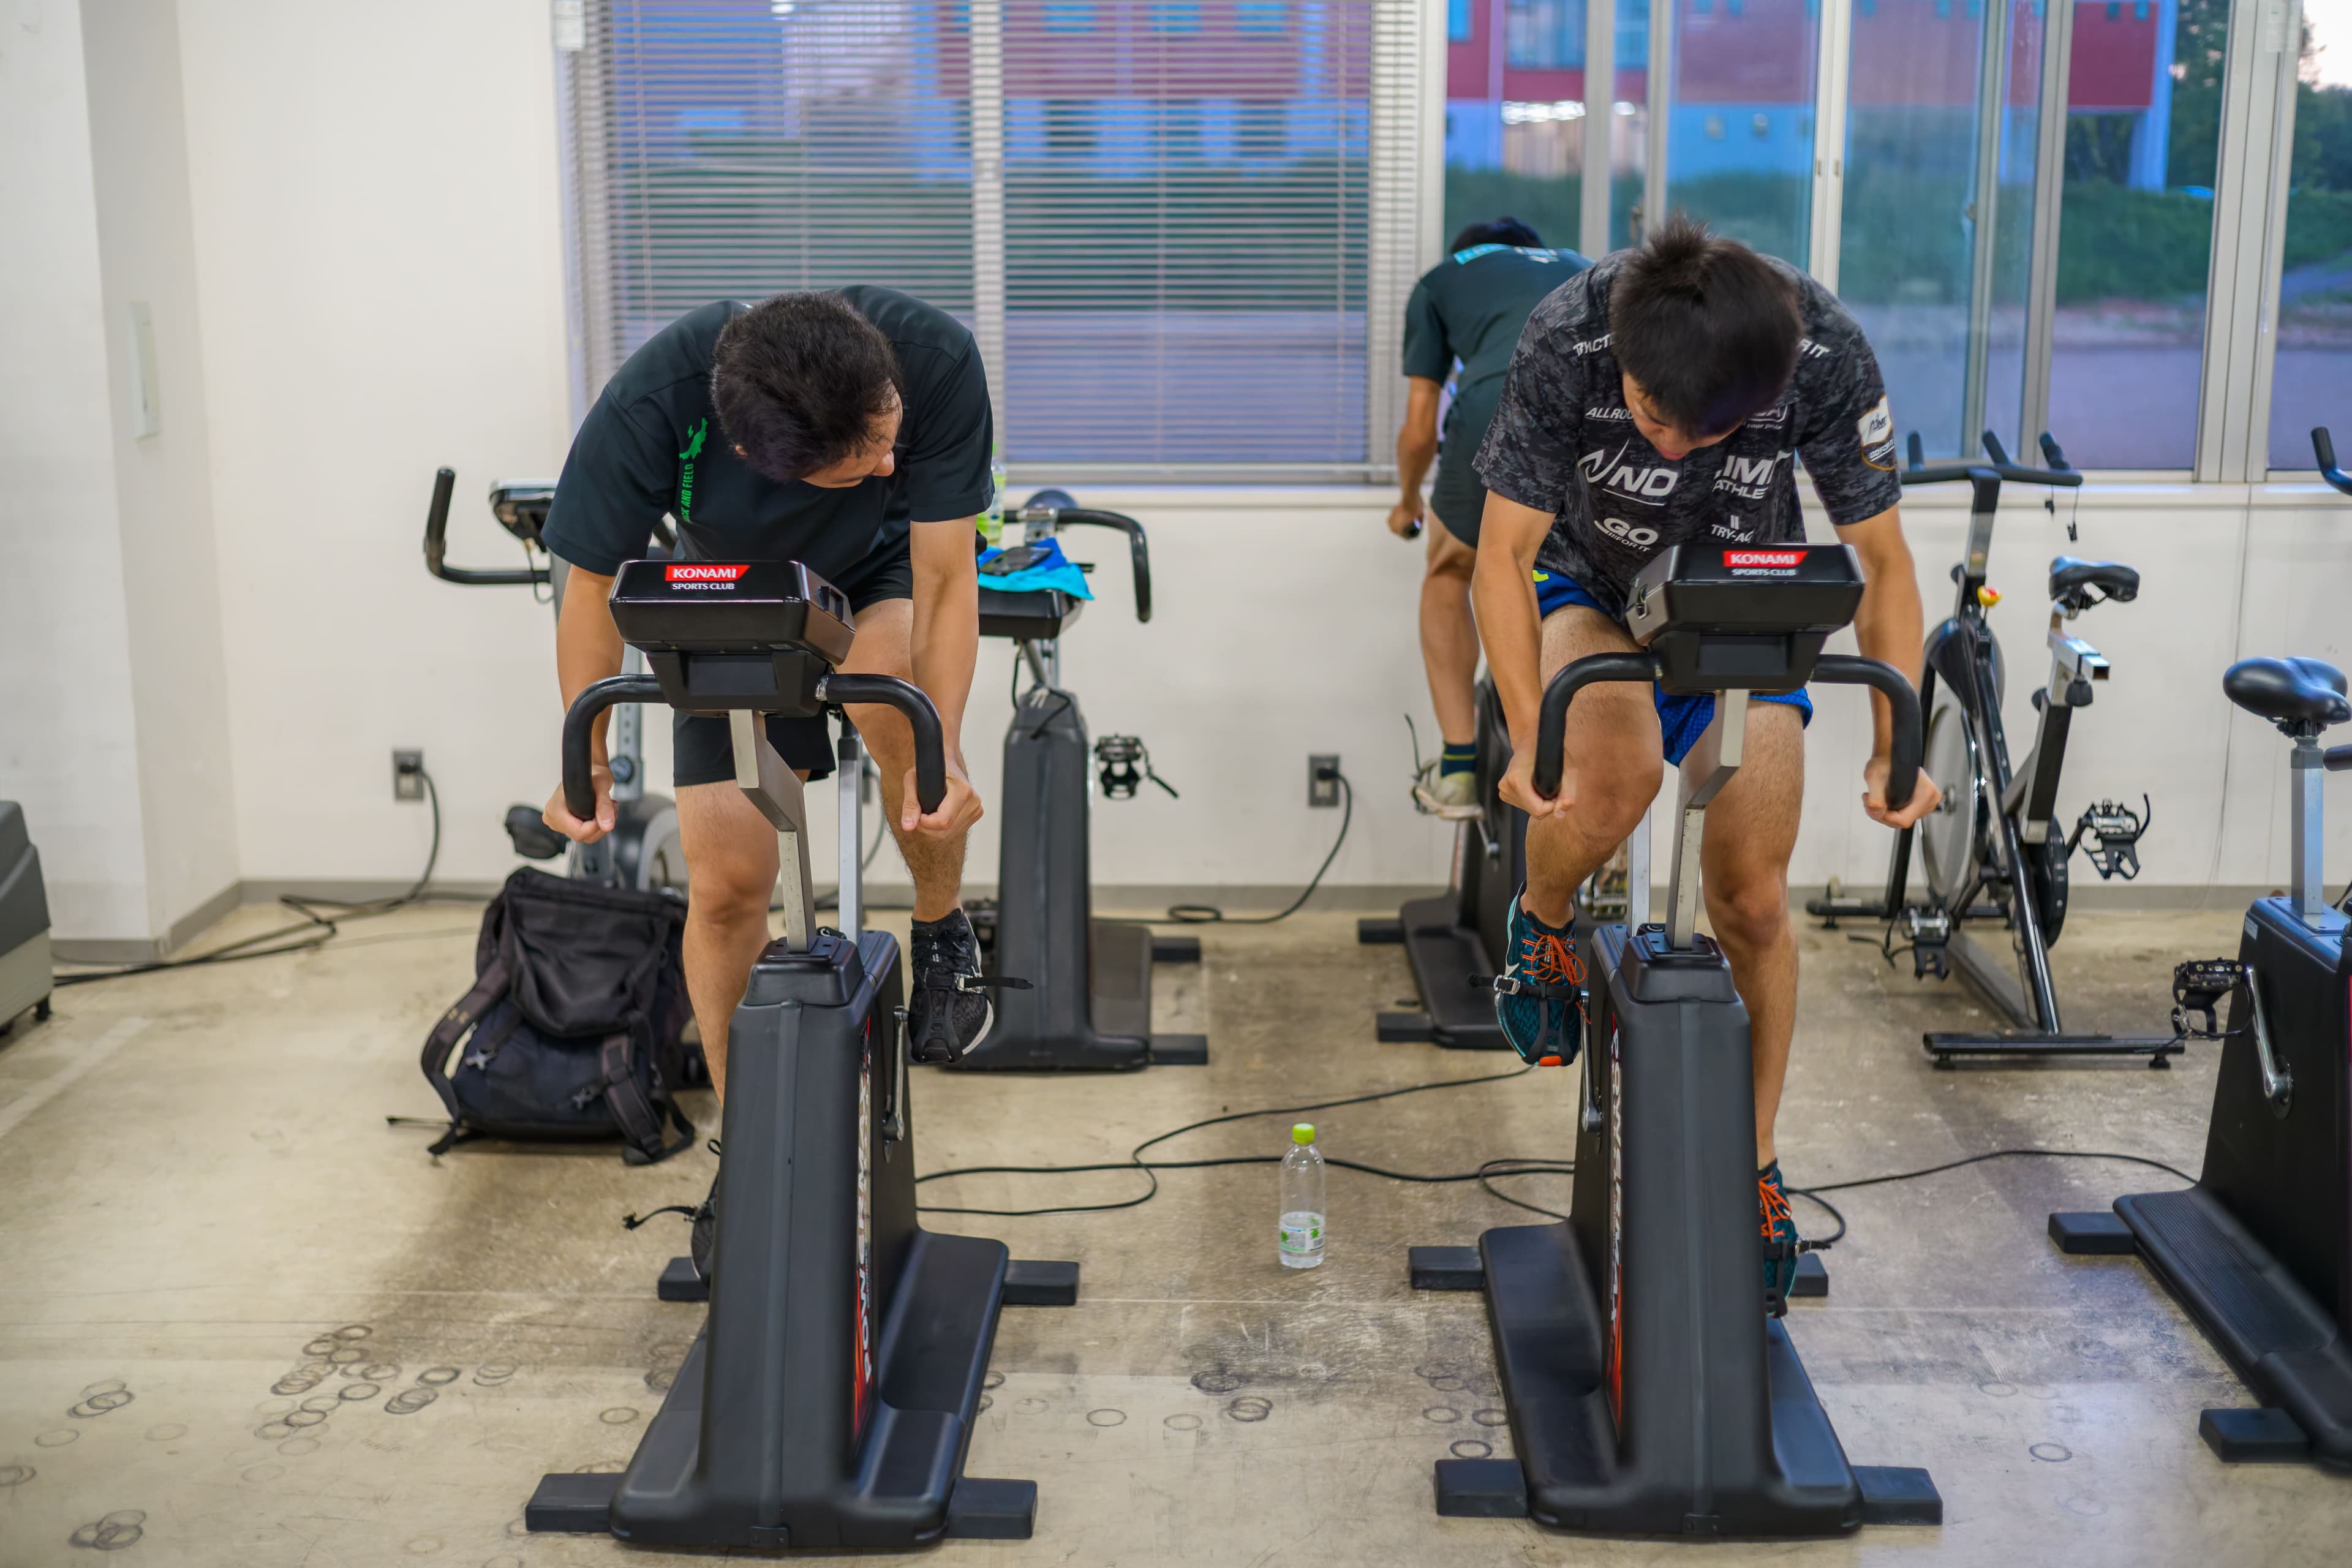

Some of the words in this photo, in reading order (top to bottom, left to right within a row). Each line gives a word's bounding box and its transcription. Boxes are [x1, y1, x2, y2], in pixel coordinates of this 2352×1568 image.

[1809, 344, 1830, 358] IT
[1585, 407, 1634, 420] ALLROU
[682, 463, 694, 488] FIELD
[681, 490, 692, 508] AND
[1604, 518, 1659, 545] GO
[1616, 535, 1638, 549] FOR
[1730, 554, 1796, 565] KONAMI
[673, 568, 737, 578] KONAMI
